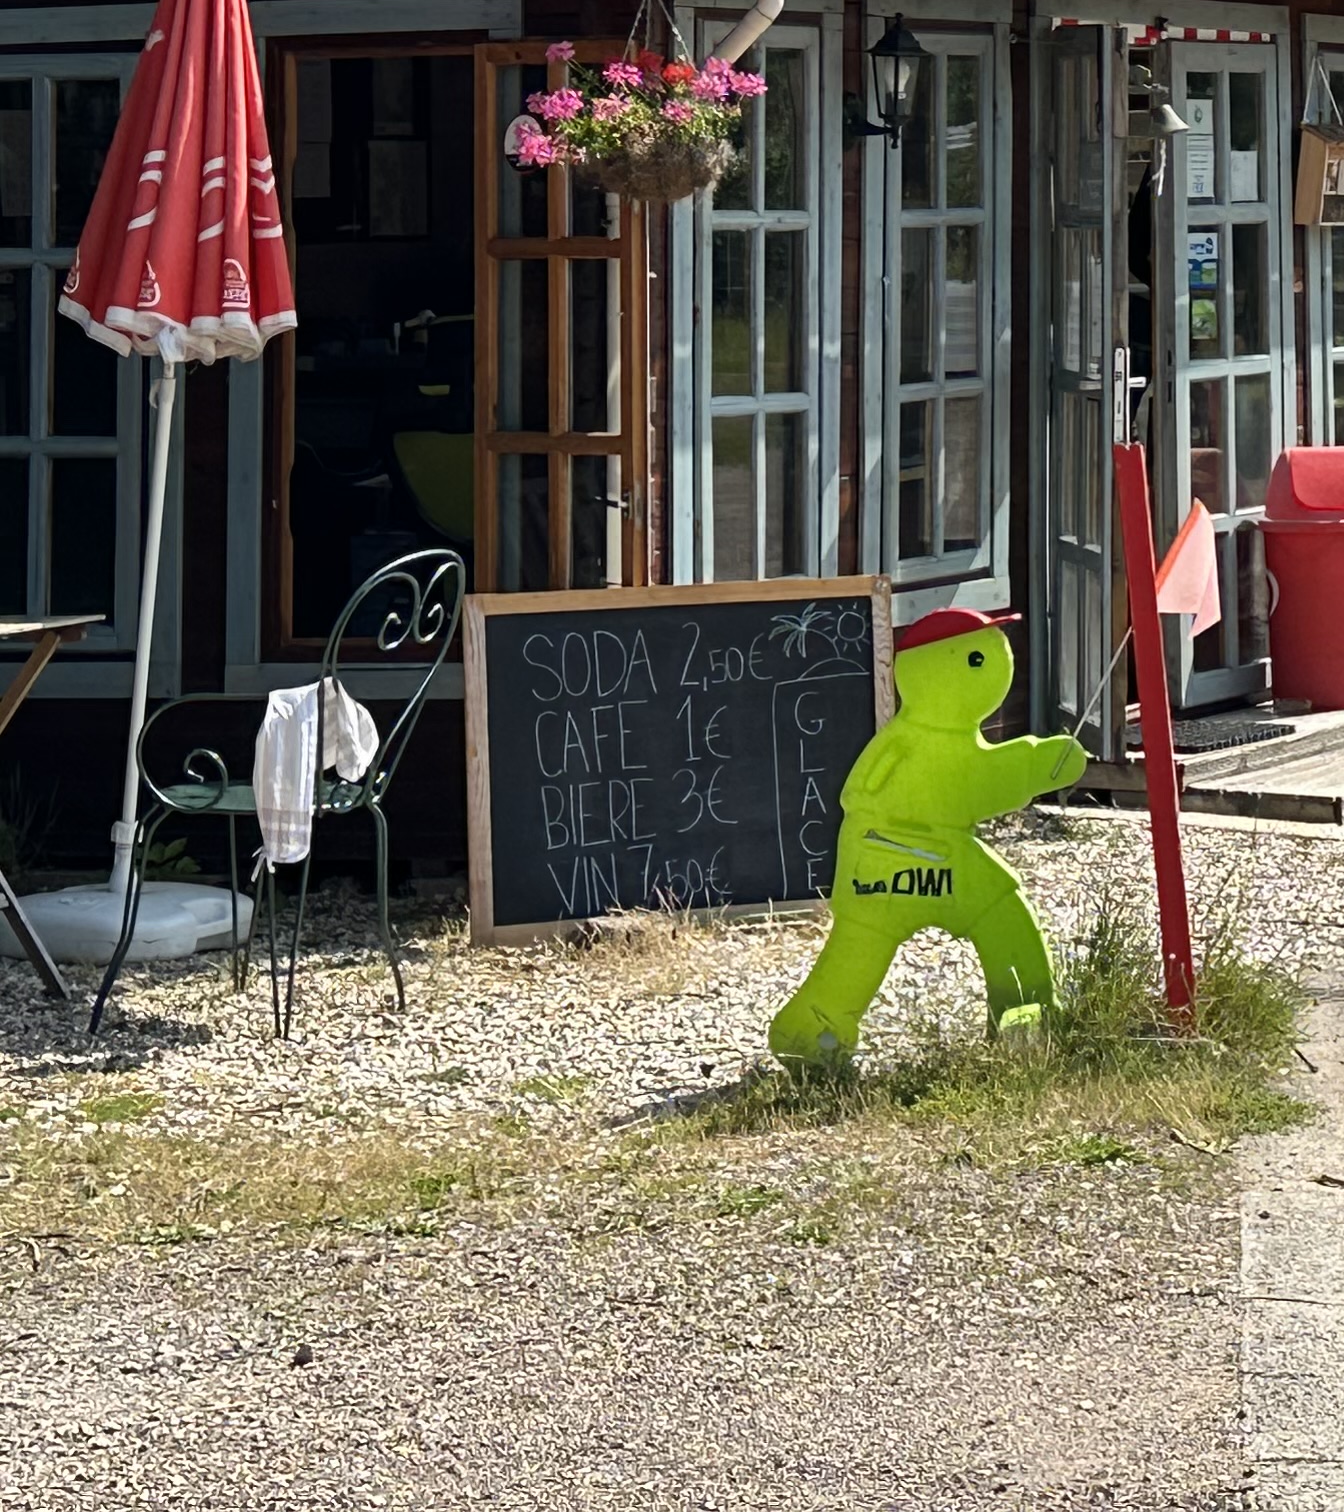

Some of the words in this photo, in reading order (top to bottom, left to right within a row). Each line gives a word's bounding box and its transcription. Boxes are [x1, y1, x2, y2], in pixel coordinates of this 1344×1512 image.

[522, 629, 658, 702] SODA
[534, 699, 649, 778] CAFE
[675, 695, 732, 762] 1€
[541, 777, 657, 850] BIERE
[671, 765, 739, 833] 3€
[546, 852, 621, 916] VIN
